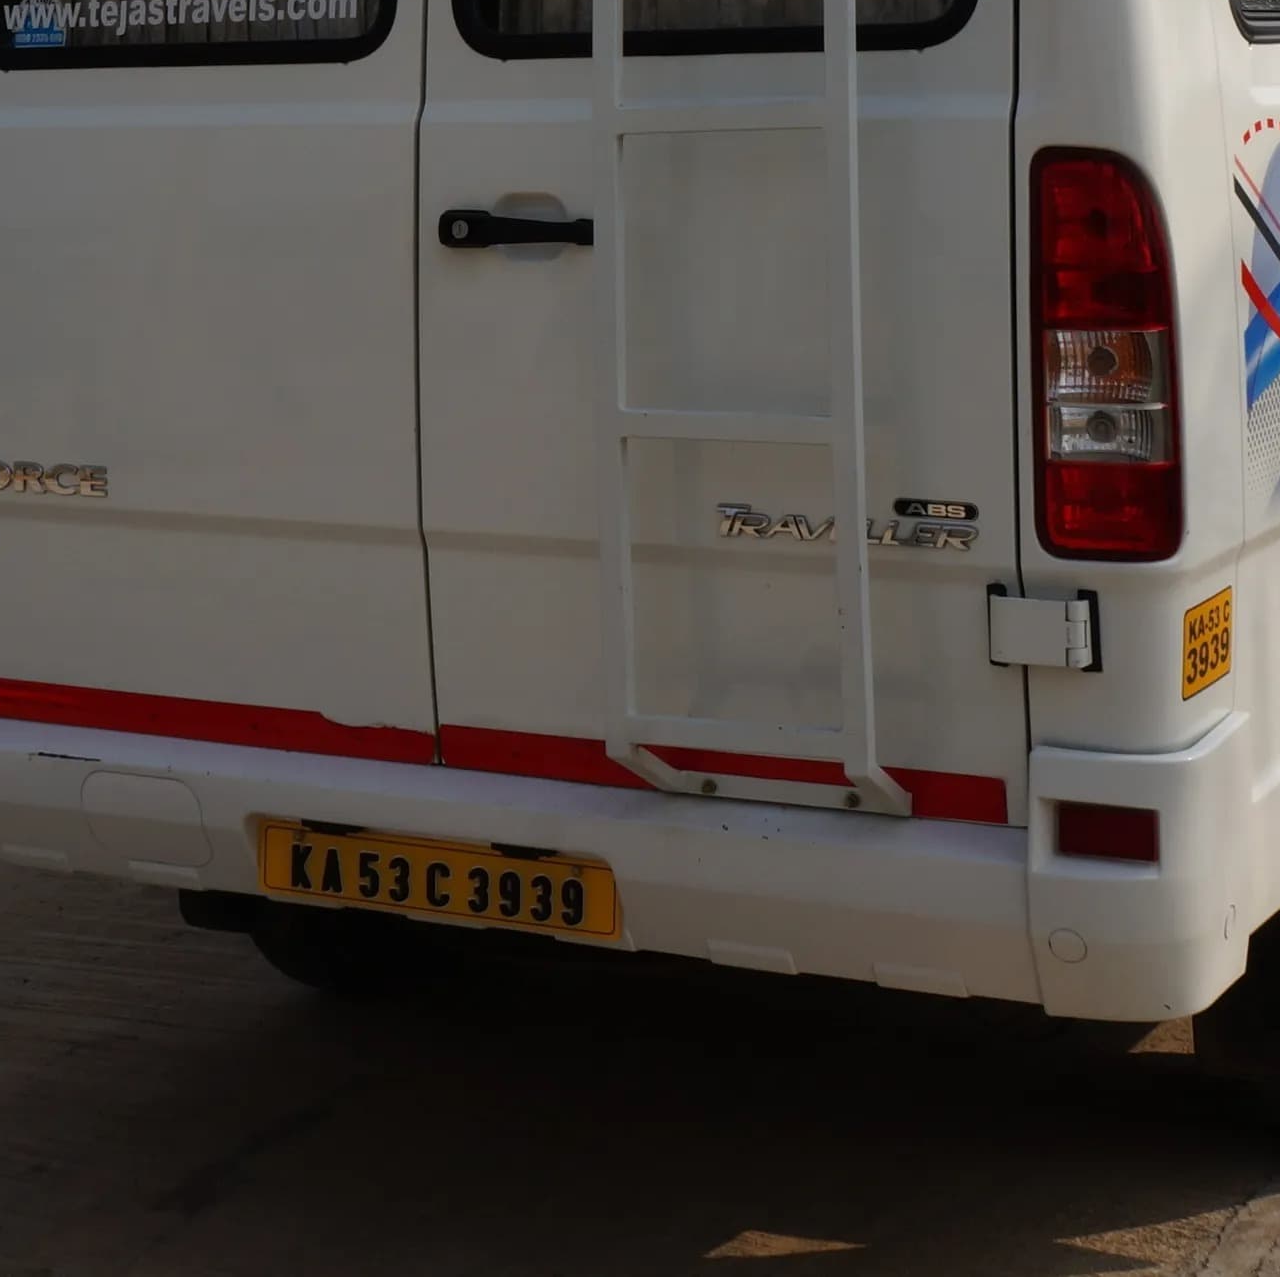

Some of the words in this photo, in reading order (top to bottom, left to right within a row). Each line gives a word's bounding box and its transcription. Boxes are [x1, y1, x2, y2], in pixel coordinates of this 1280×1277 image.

[716, 503, 980, 552] TRAVLLER
[904, 501, 967, 519] ABS
[1186, 627, 1230, 685] 3939
[291, 843, 343, 894] KA
[358, 851, 411, 903] 53
[426, 862, 451, 908] C
[468, 867, 584, 926] 3939
